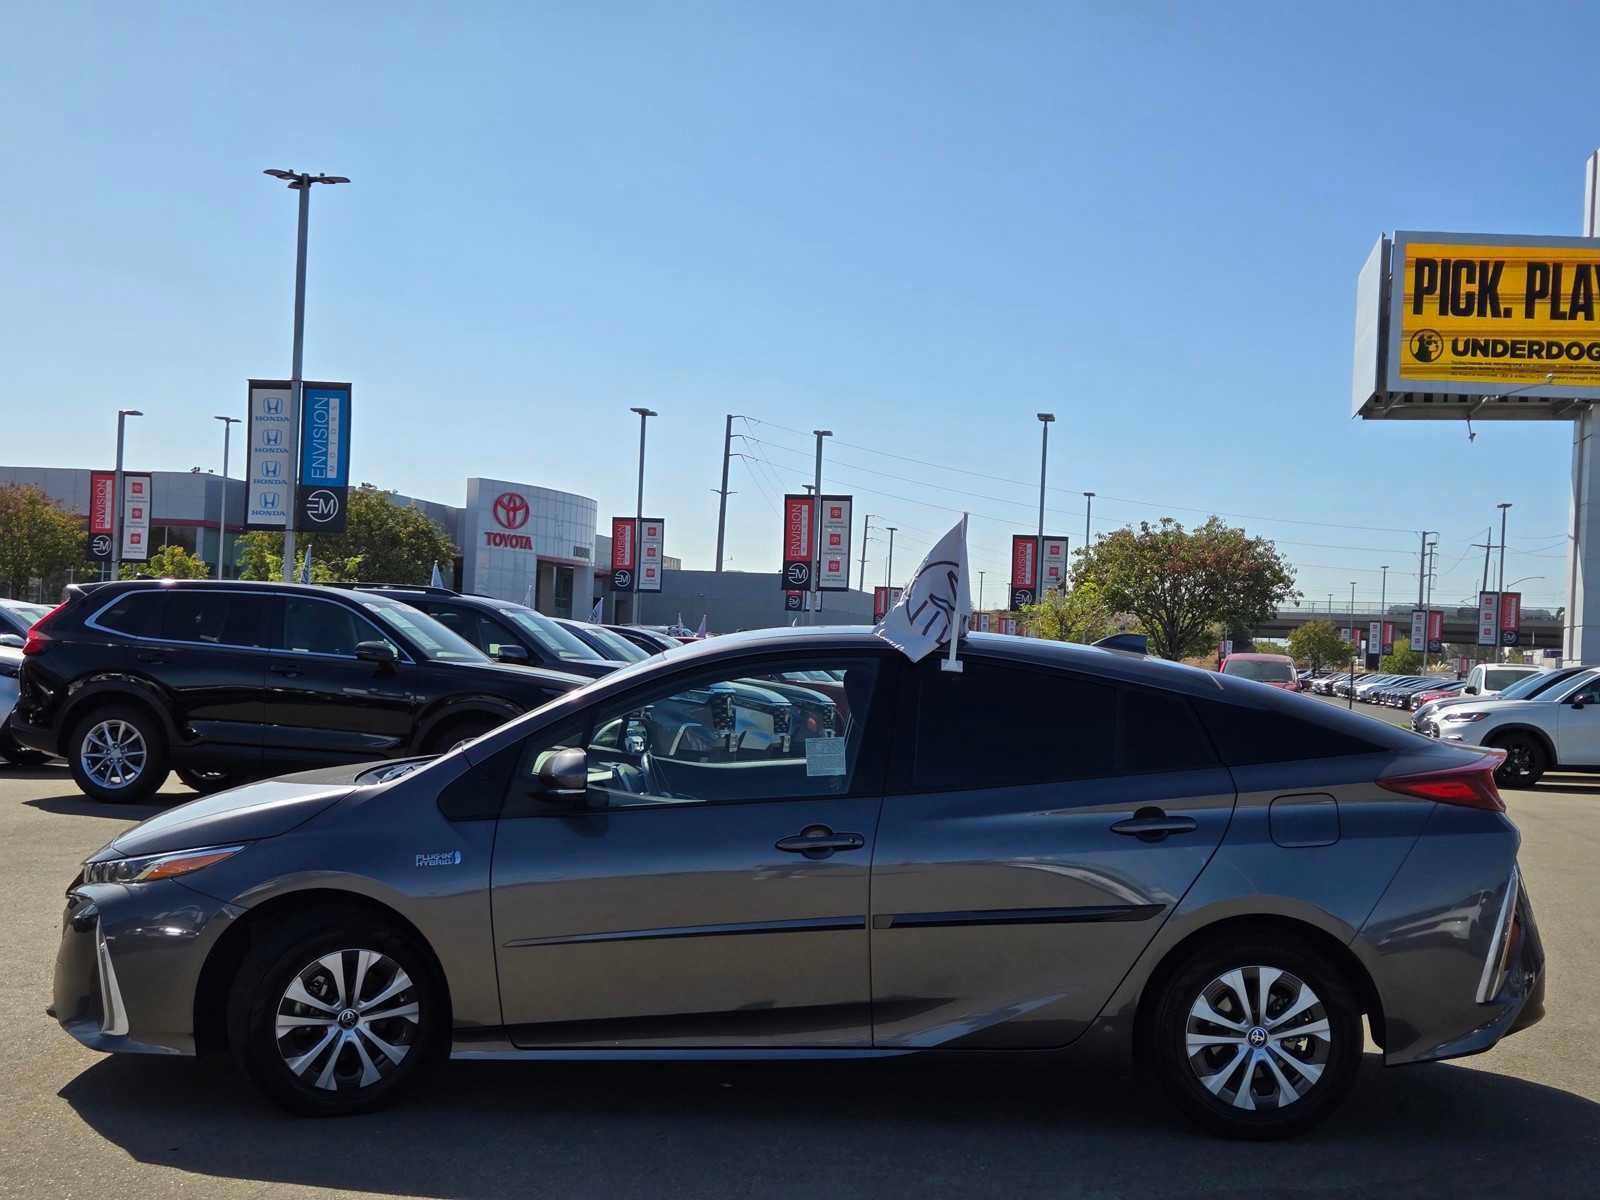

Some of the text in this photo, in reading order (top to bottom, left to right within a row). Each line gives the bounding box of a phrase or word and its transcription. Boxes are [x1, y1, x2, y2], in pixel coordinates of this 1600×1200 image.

[1412, 258, 1600, 321] PICK. PLA
[1451, 338, 1600, 361] UNDERDOG
[311, 397, 329, 479] ENVISION
[95, 479, 106, 529] ENVISION
[484, 532, 533, 550] TOYOTA
[791, 504, 801, 557] ENVISION
